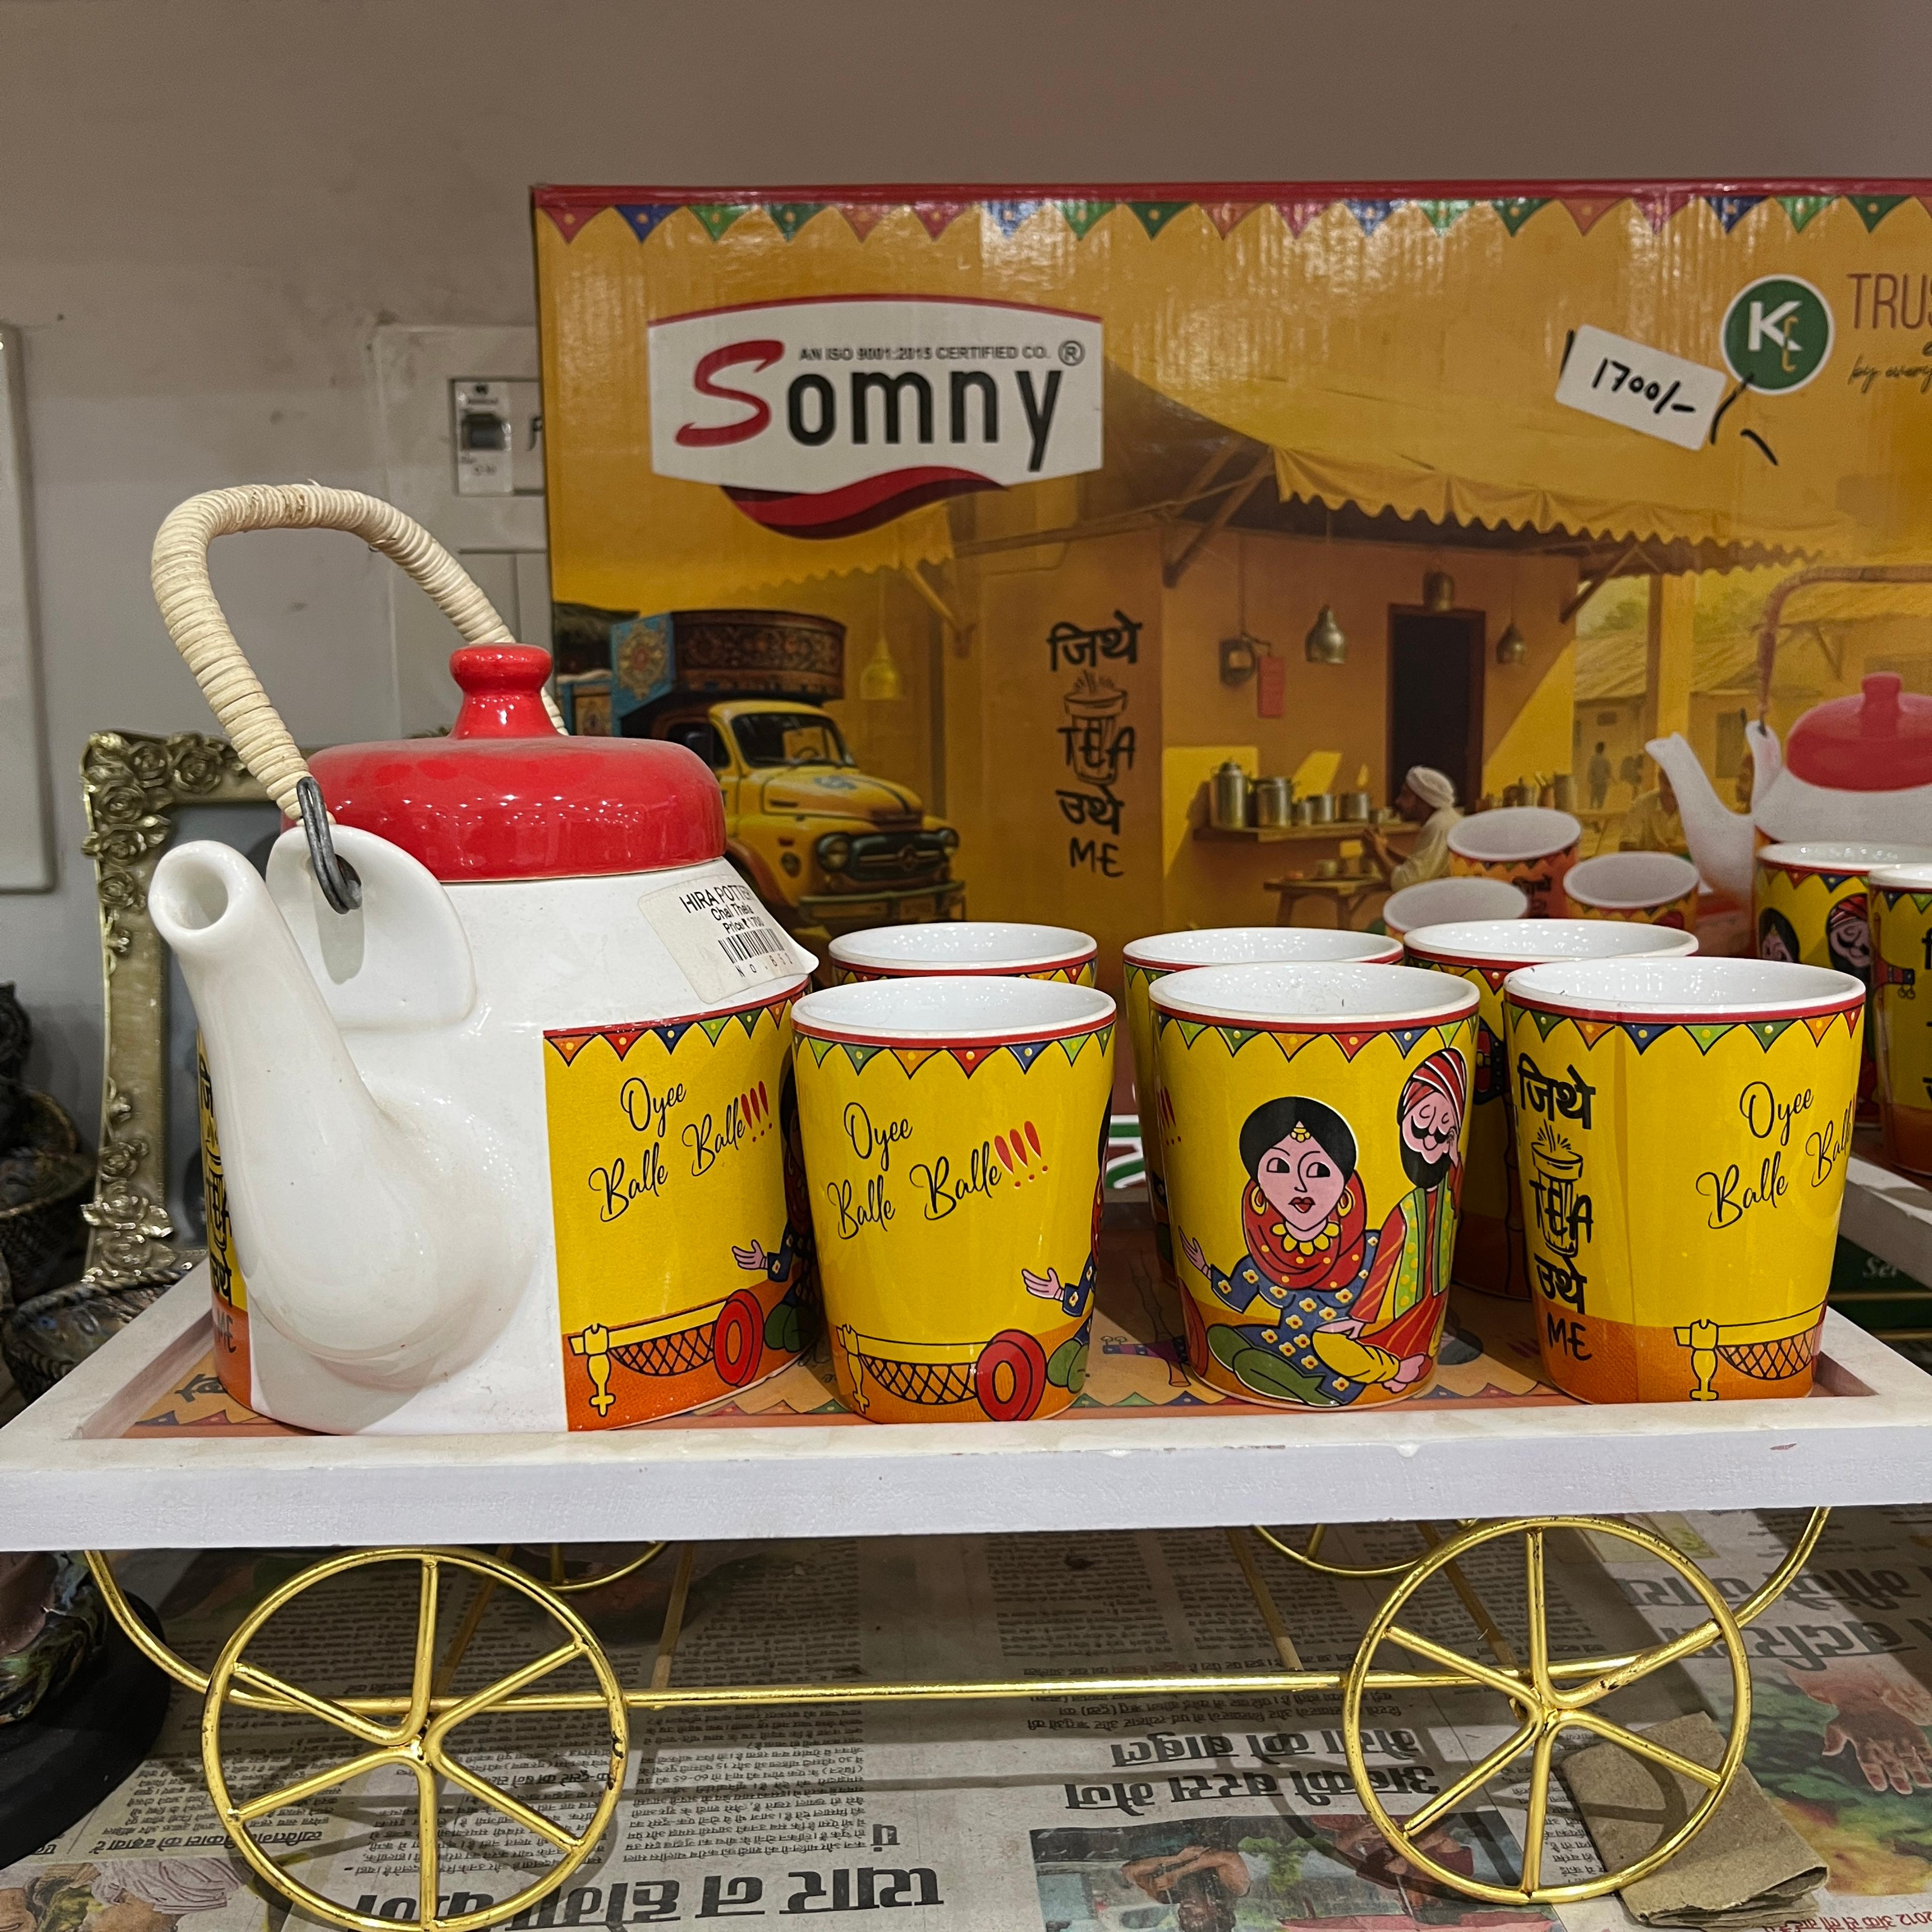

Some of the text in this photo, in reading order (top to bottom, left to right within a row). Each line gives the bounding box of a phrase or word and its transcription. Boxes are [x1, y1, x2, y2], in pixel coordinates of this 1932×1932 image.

[1846, 273, 1932, 330] TRU
[799, 348, 822, 361] AN
[826, 347, 853, 361] ISO
[857, 347, 933, 361] 9001:2015
[935, 346, 1018, 360] CERTIFIED
[1022, 345, 1050, 359] CO.
[675, 339, 1063, 472] Somny
[1592, 358, 1695, 414] 1700/-
[1058, 726, 1136, 771] TEA
[1069, 837, 1124, 878] ME
[679, 889, 719, 914] HIRA
[620, 1077, 687, 1138] Oyee
[1739, 1081, 1815, 1147] Oyee
[843, 1101, 914, 1172] Oyee
[588, 1142, 669, 1223] Balle
[826, 1174, 896, 1240] Balle
[1695, 1151, 1789, 1230] Balle
[1528, 1178, 1594, 1244] TEA
[1546, 1311, 1593, 1361] ME
[1110, 1732, 1240, 1767] बाबुल
[1245, 1733, 1316, 1765] को
[559, 1770, 609, 1787] क-दूसरे
[1064, 1765, 1440, 1817] अबकी बरस भेज
[695, 1875, 765, 1918] न
[779, 1867, 944, 1915] प्यार
